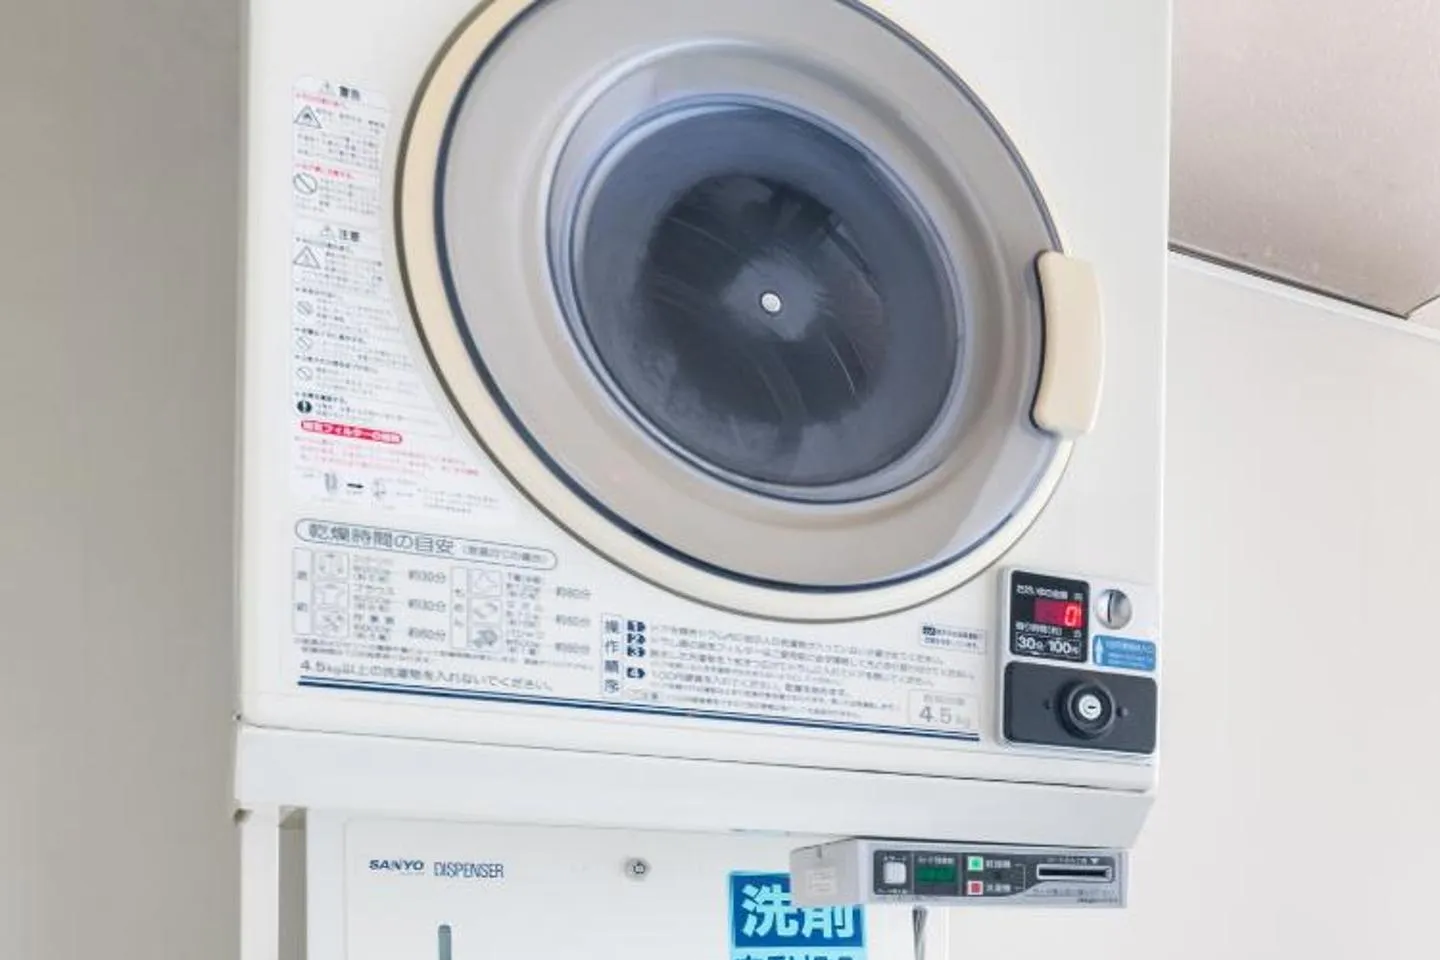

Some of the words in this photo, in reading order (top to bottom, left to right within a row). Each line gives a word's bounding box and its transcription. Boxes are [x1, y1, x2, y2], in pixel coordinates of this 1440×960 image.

[309, 523, 454, 554] 乾燥時間の目安
[1064, 605, 1081, 627] 0
[369, 859, 425, 872] SANYO
[433, 861, 504, 879] DISPENSER
